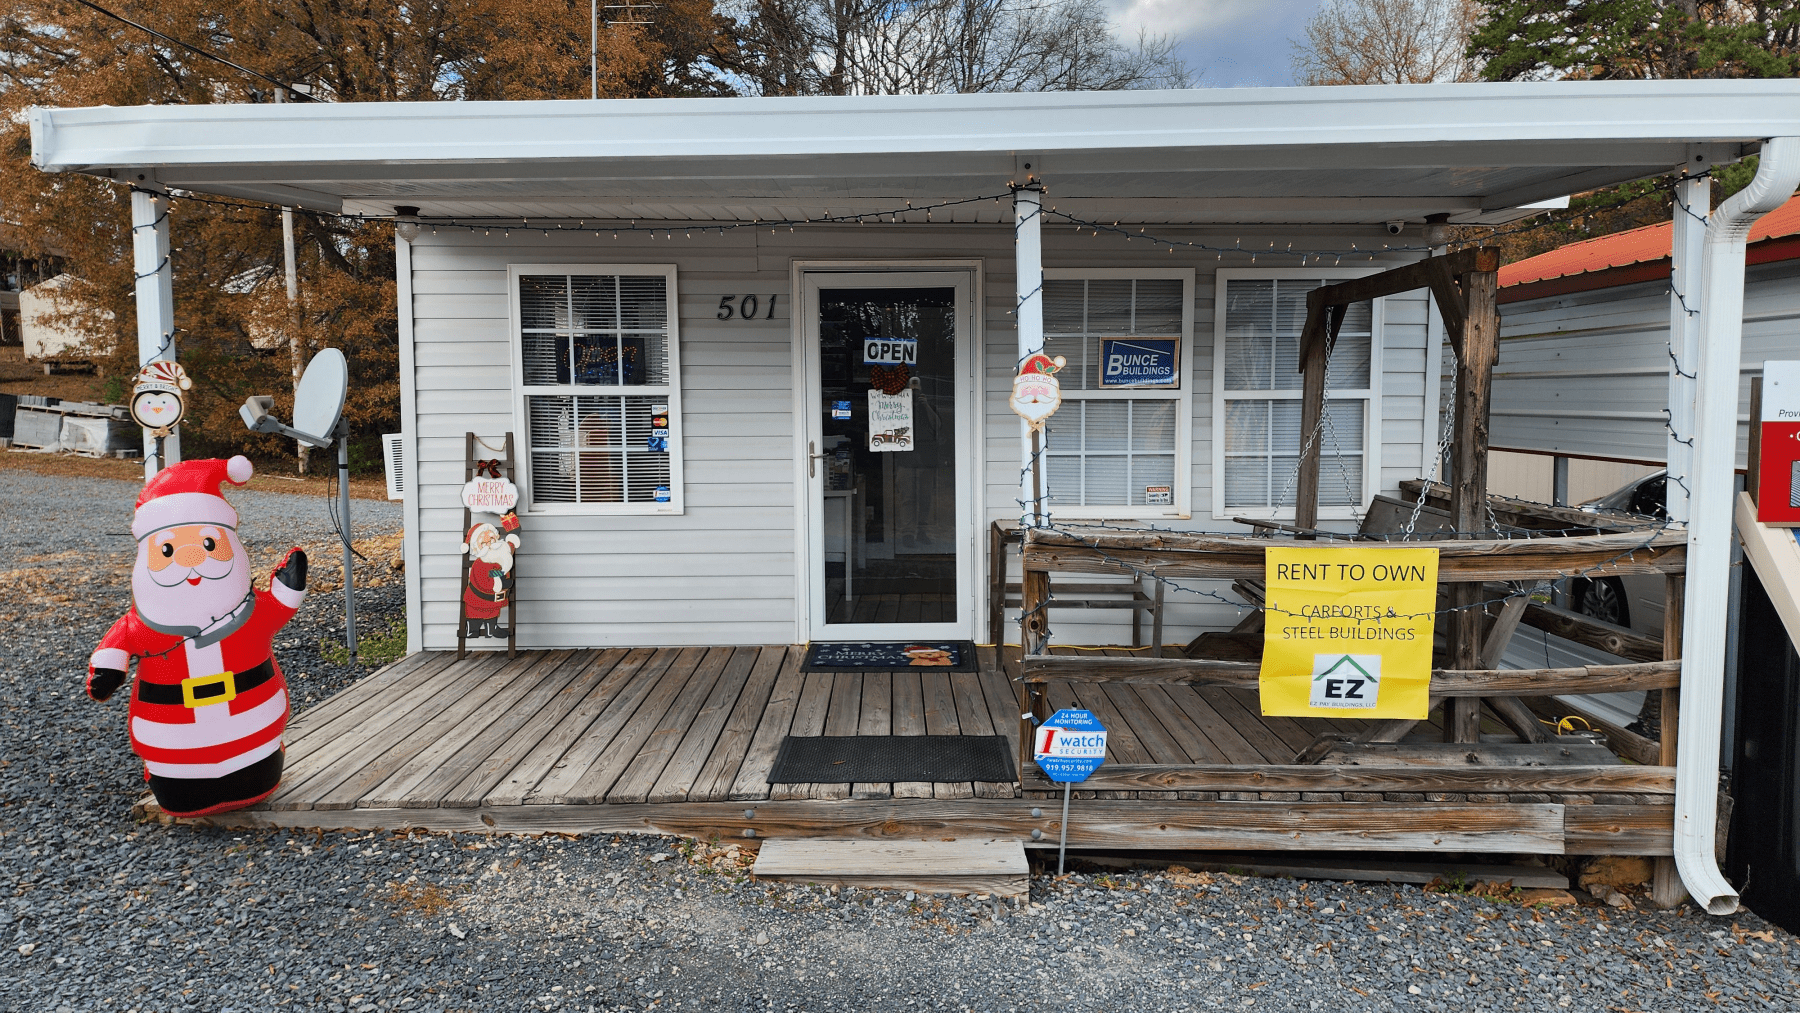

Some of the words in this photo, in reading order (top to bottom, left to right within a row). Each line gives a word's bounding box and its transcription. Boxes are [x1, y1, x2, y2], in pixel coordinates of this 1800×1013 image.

[717, 294, 777, 320] 501
[867, 342, 914, 362] OPEN
[1107, 354, 1159, 375] BUNCE
[1123, 366, 1170, 375] BUILDINGS
[136, 383, 153, 391] MERRY
[160, 383, 178, 392] BRIGHT
[477, 481, 505, 494] MERRY
[467, 494, 514, 506] CHRISTMAS
[1277, 563, 1331, 581] RENT
[1337, 564, 1365, 581] TO
[1372, 565, 1425, 582] OWN
[1301, 604, 1381, 619] CARPORTS
[1386, 605, 1397, 619] &
[1283, 626, 1325, 640] STEEL
[1329, 627, 1416, 641] BUILDINGS
[1325, 678, 1365, 699] EZ
[1038, 729, 1058, 754] I
[1060, 733, 1104, 747] watch
